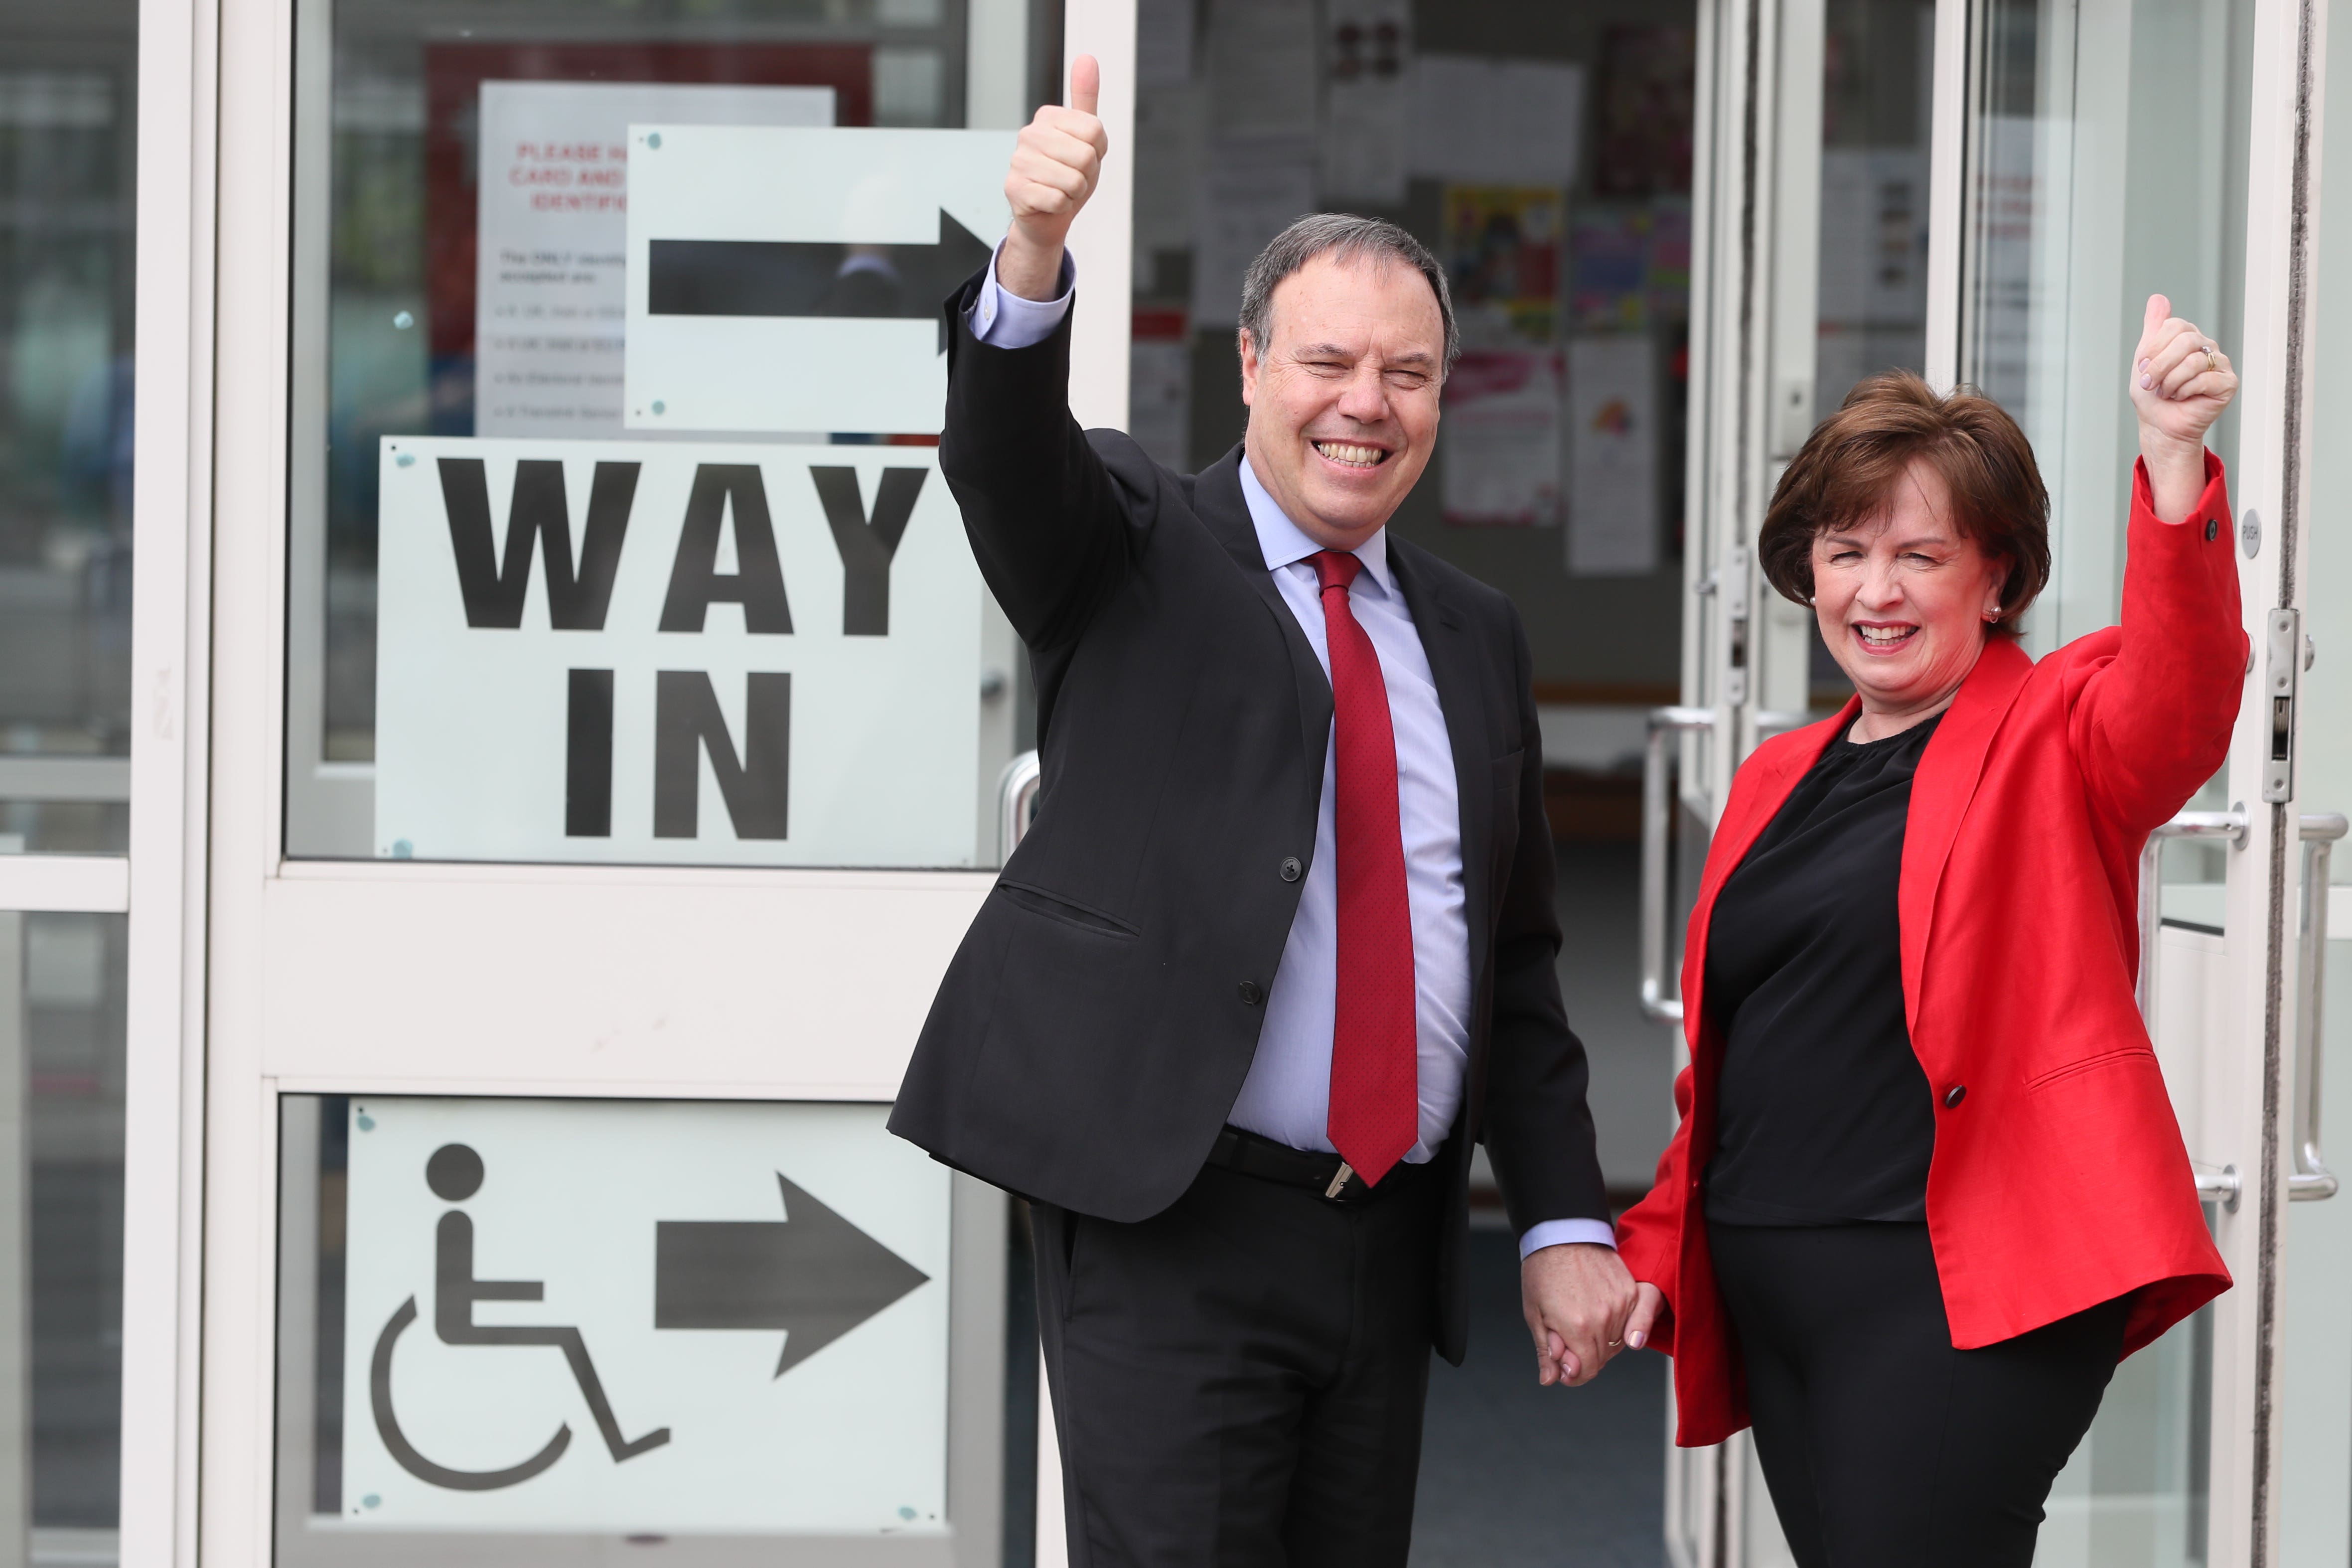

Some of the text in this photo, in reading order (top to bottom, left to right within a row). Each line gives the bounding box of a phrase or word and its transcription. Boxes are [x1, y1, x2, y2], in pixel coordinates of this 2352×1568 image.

[437, 457, 930, 637] WAY
[2242, 525, 2258, 540] PUSH
[565, 668, 792, 841] IN
